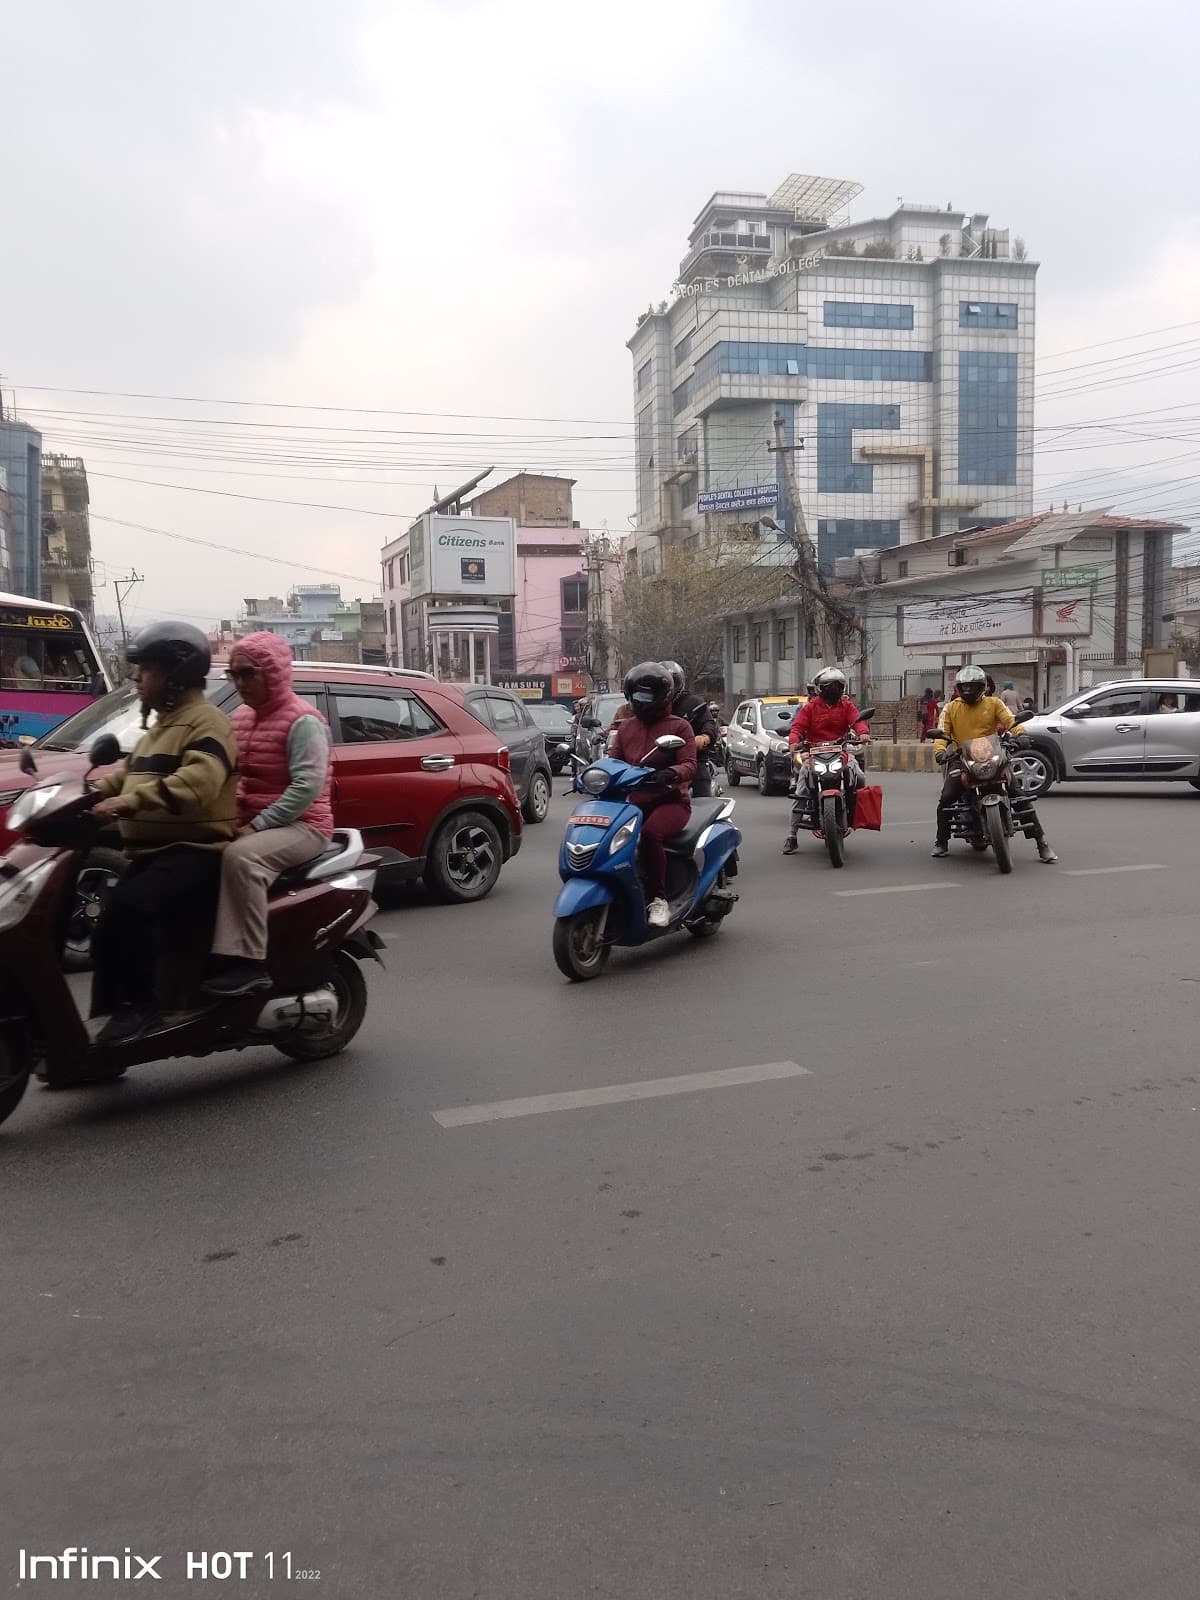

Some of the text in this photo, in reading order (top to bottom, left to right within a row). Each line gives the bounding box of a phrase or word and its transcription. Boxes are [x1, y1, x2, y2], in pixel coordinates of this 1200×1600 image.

[727, 269, 767, 288] DENTAL
[773, 255, 821, 277] COLLEGE
[718, 492, 733, 500] DENTAL
[734, 488, 752, 497] COLLEGE
[758, 486, 777, 494] HOSPITAL
[438, 535, 487, 547] Citizens
[952, 622, 969, 634] Bike
[498, 681, 546, 689] SAMSUNG
